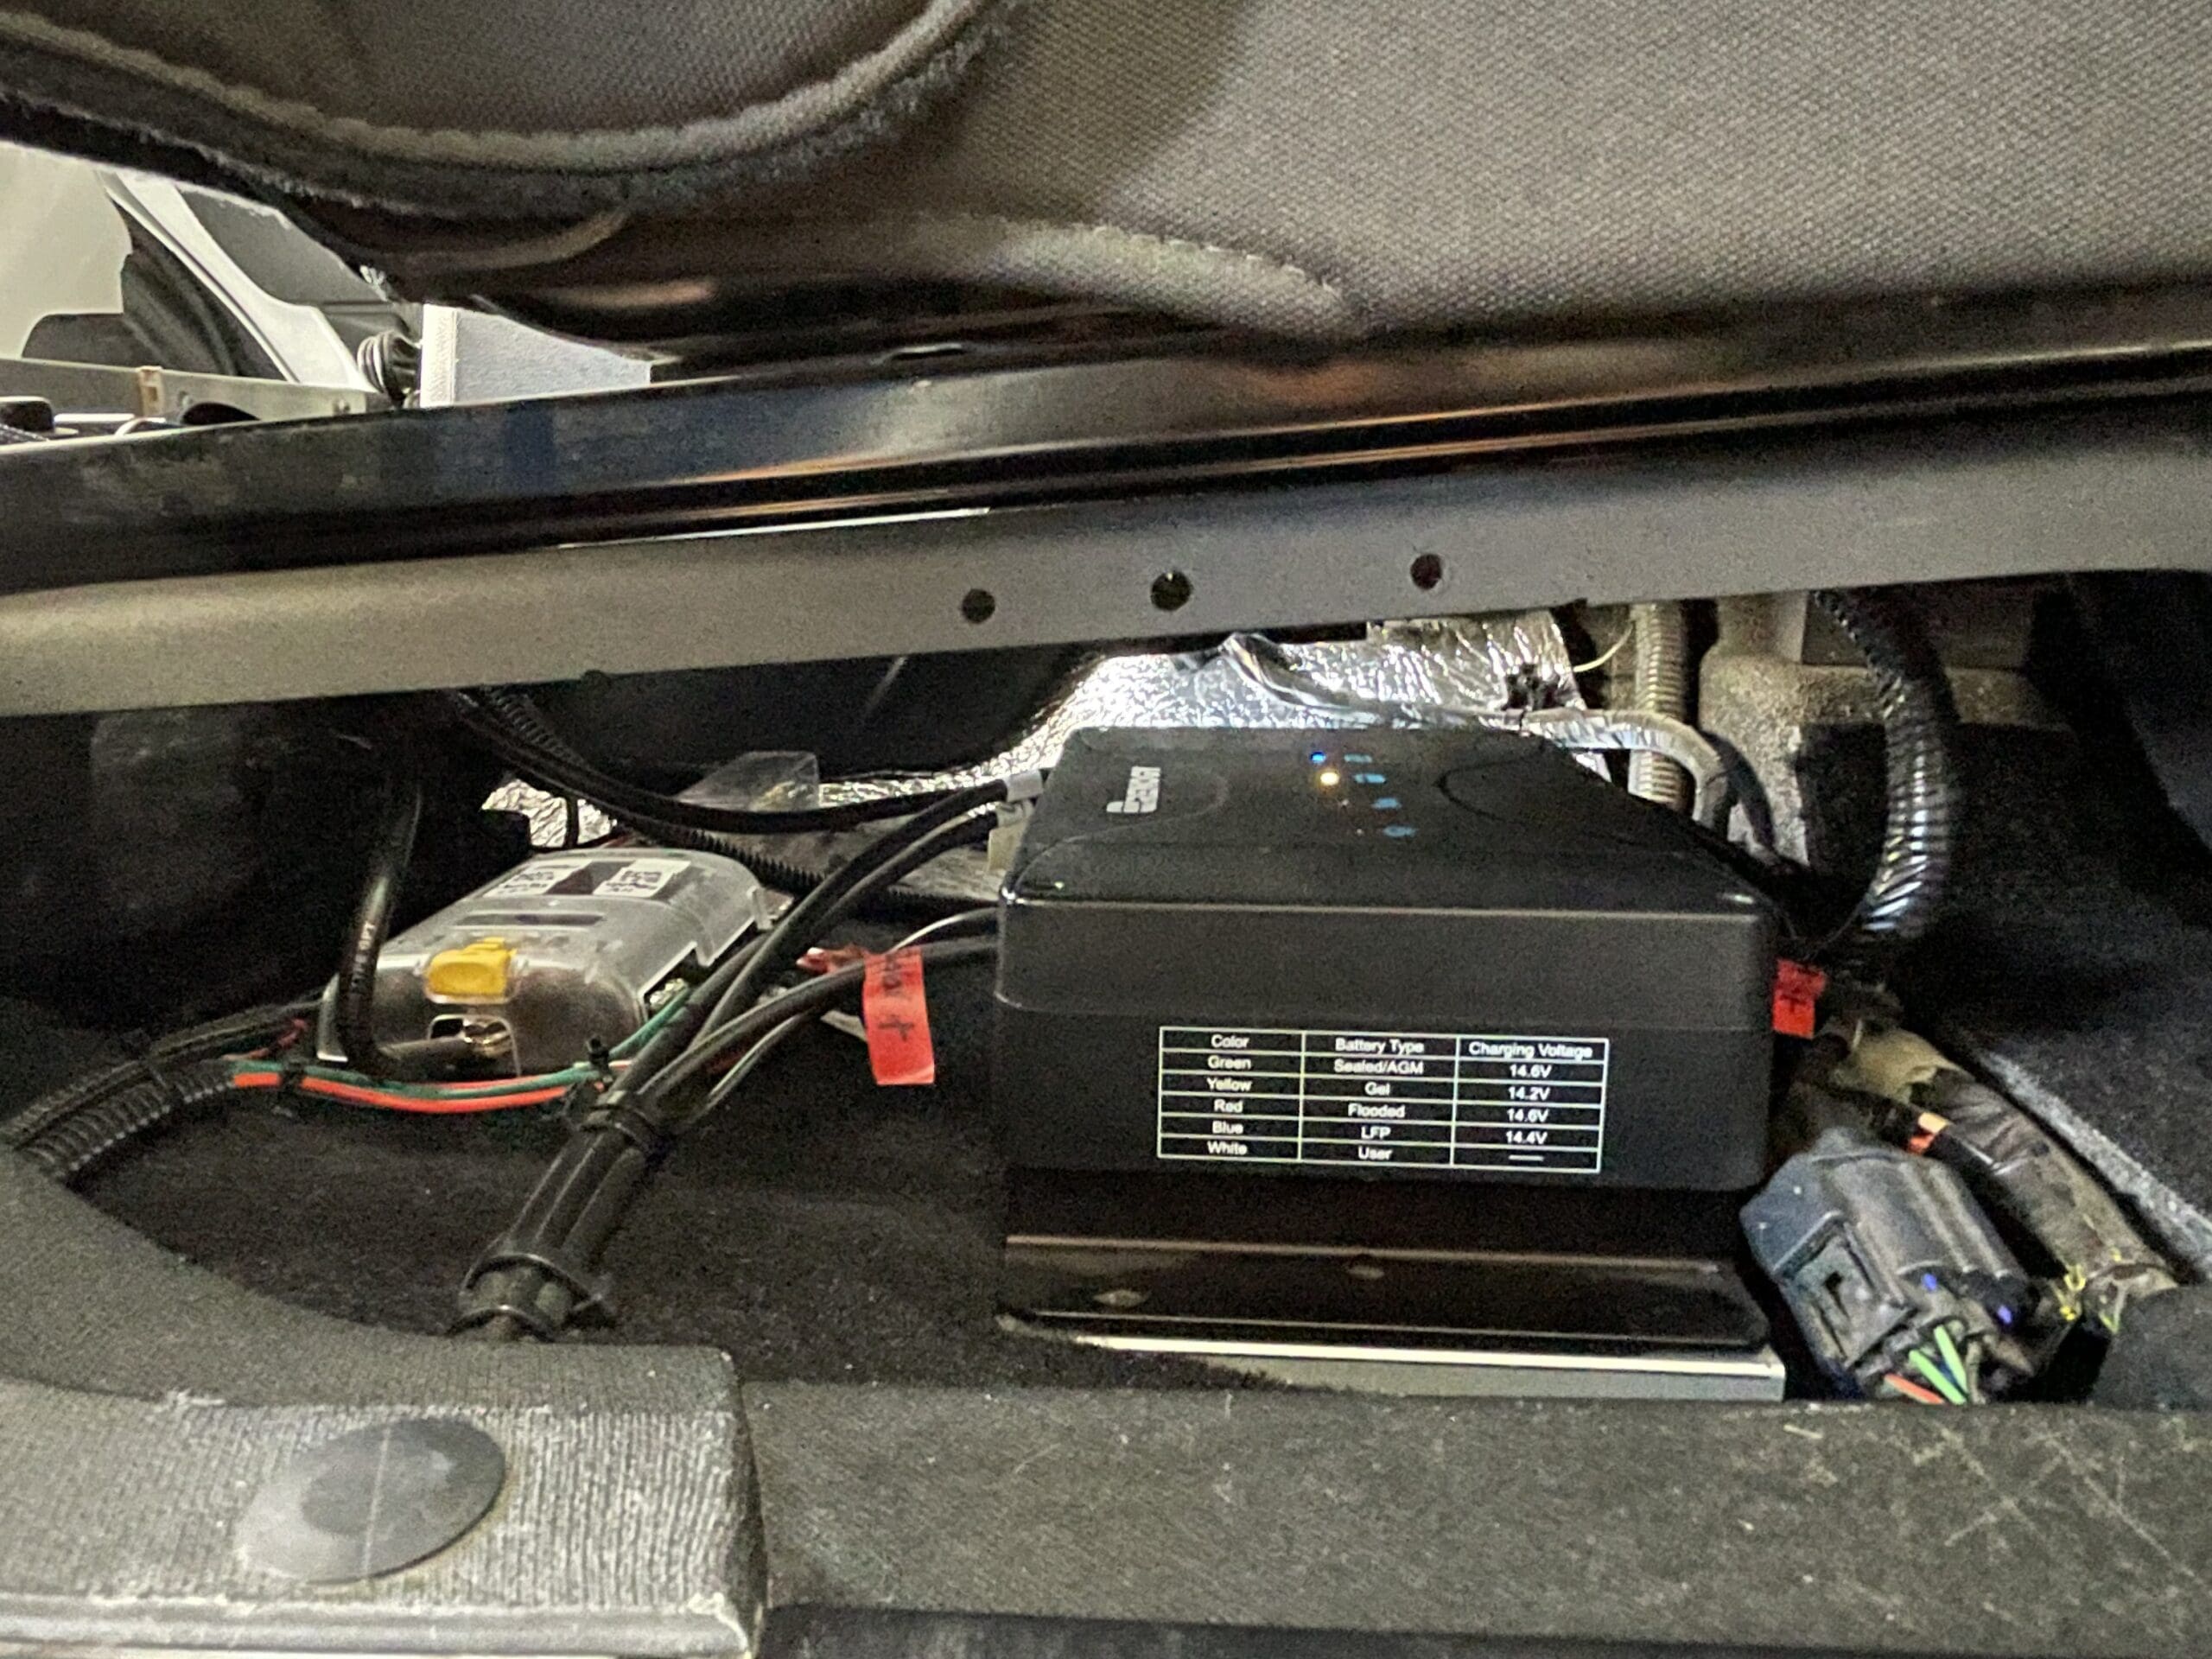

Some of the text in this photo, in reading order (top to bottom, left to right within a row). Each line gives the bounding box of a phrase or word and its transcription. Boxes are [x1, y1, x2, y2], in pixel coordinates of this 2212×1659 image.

[1211, 1034, 1249, 1048] Color
[1335, 1038, 1425, 1054] Battery Type
[1469, 1041, 1593, 1062] Charging Voltage
[1208, 1055, 1251, 1070] Green
[1334, 1058, 1424, 1075] Sealed/AGM
[1510, 1065, 1552, 1078] 14.6V
[1207, 1077, 1252, 1091] Yellow
[1364, 1082, 1390, 1096] Gel
[1508, 1086, 1551, 1101] 14.2V
[1214, 1098, 1243, 1112] Red
[1348, 1103, 1406, 1118] Flooded
[1507, 1109, 1549, 1122] 14.6V
[1212, 1121, 1243, 1134] Blue
[1361, 1126, 1391, 1139] LFP
[1506, 1130, 1548, 1144] 14.4V
[1207, 1141, 1248, 1155] White
[1358, 1146, 1393, 1160] User
